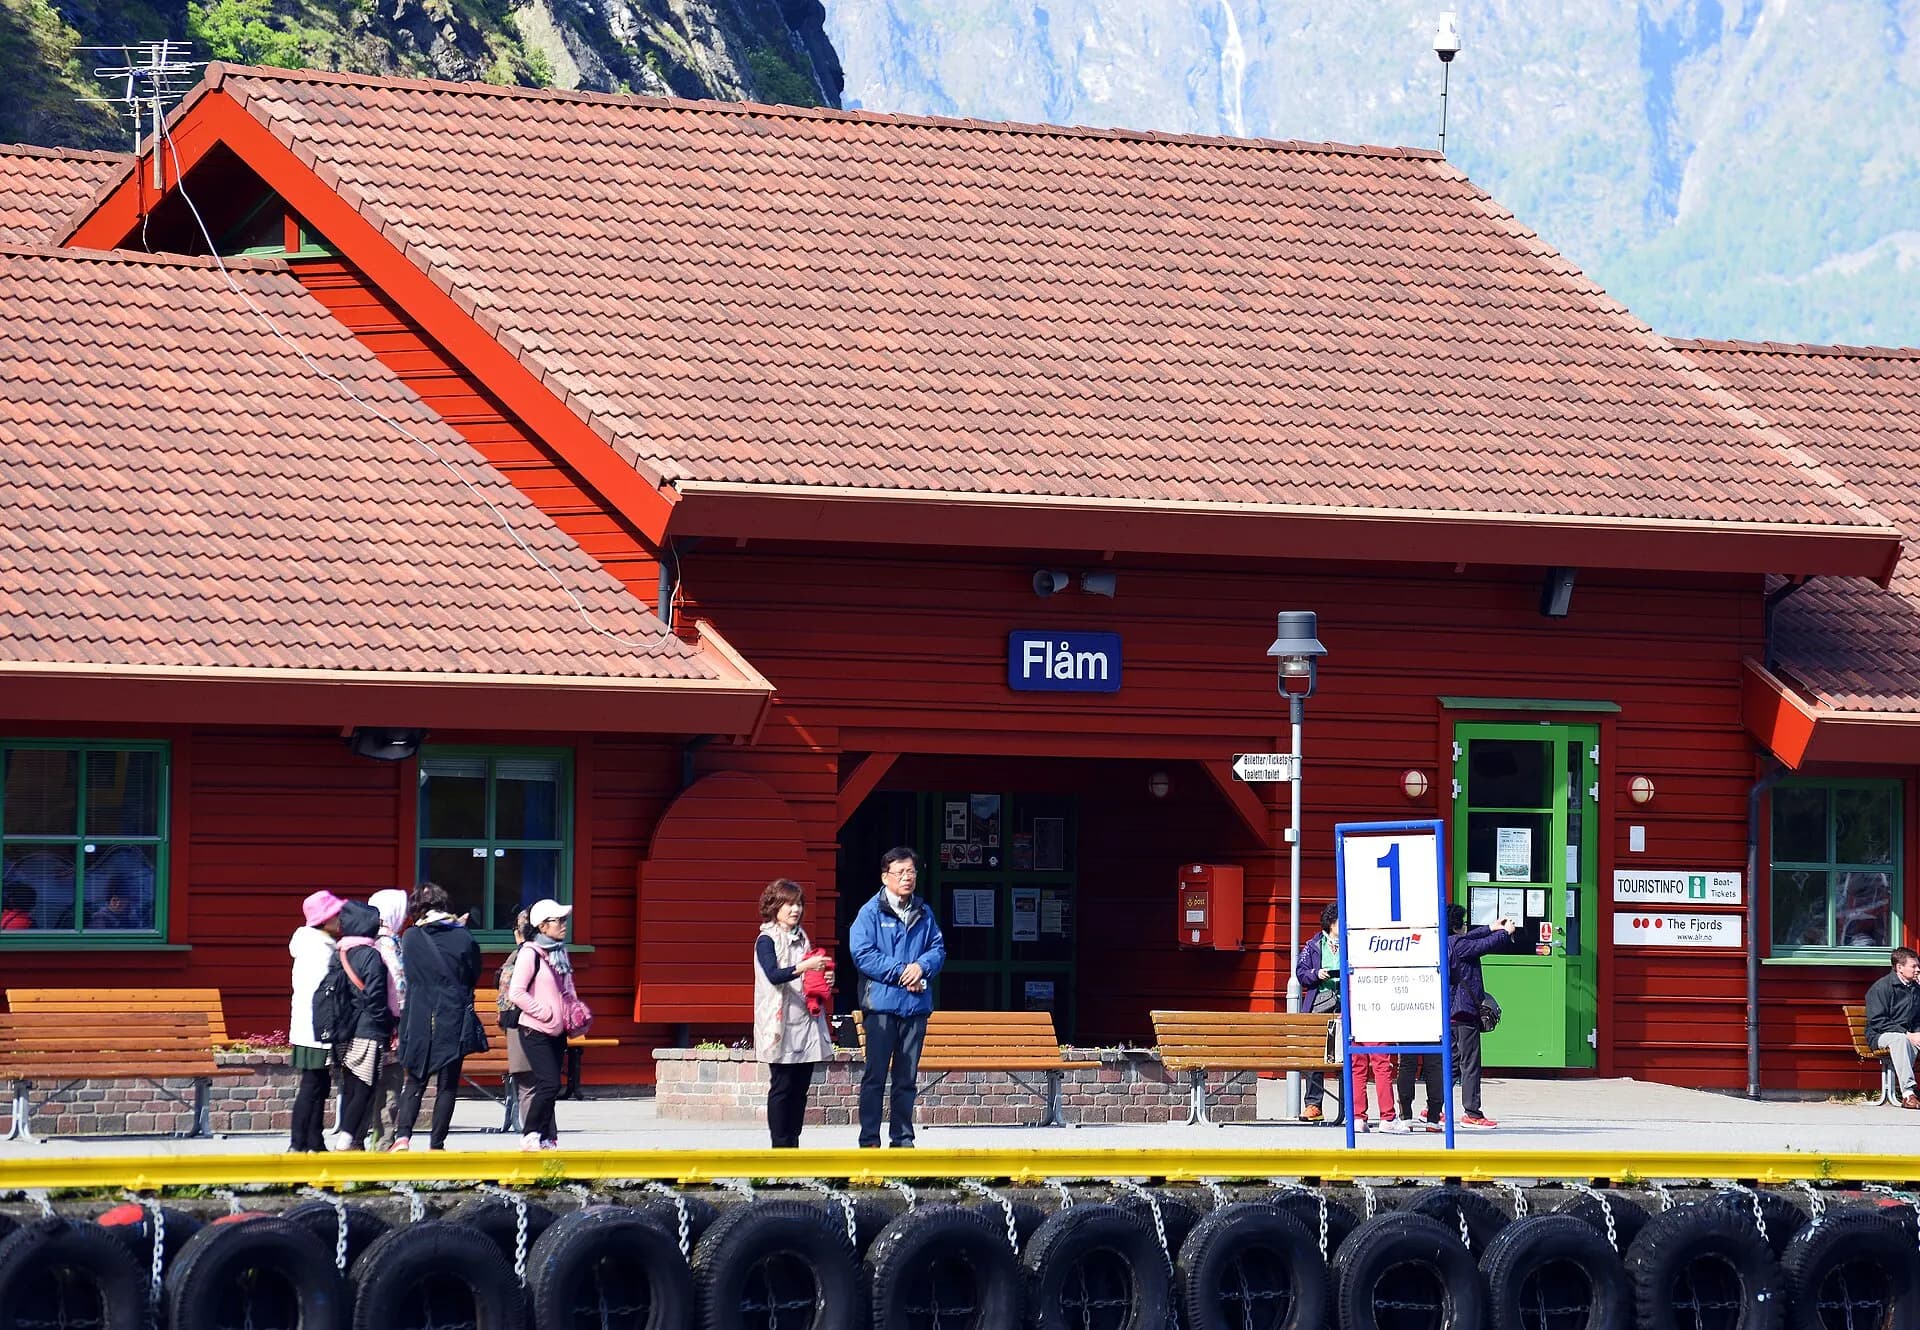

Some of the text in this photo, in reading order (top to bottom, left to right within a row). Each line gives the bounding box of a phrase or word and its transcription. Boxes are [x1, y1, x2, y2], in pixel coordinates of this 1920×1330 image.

[1023, 640, 1108, 680] Flåm
[1376, 843, 1401, 922] 1
[1618, 879, 1684, 894] TOURISTINFO
[1711, 889, 1737, 898] Tickets
[1667, 918, 1723, 932] The Fjords
[1368, 935, 1411, 953] Fjord1
[1390, 1001, 1435, 1011] GUDVANGEN
